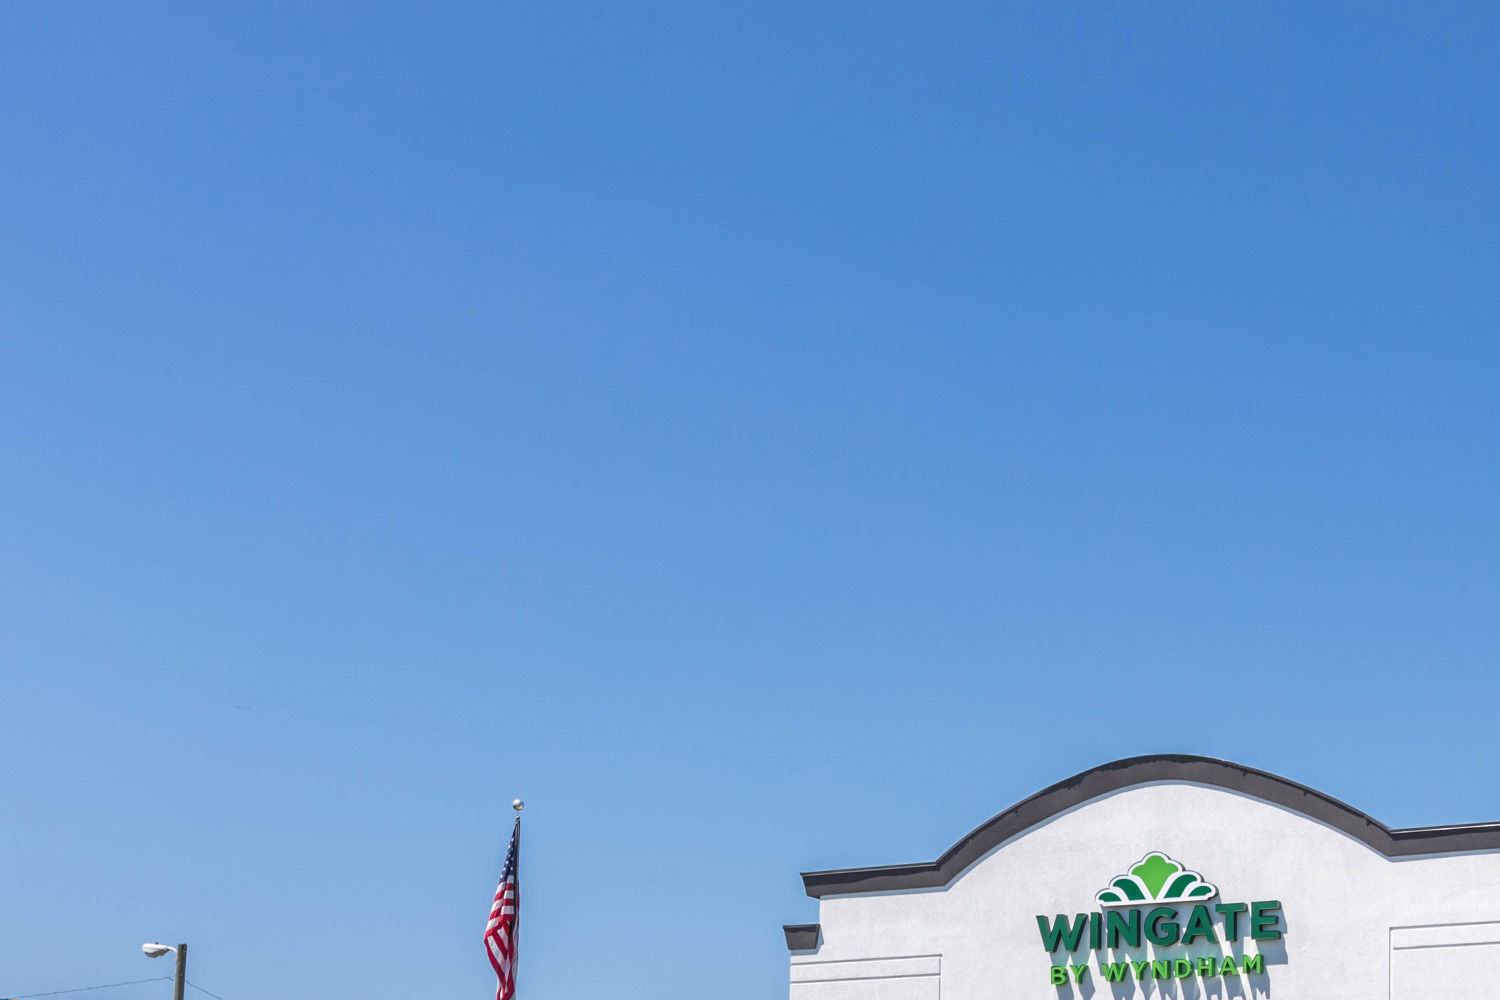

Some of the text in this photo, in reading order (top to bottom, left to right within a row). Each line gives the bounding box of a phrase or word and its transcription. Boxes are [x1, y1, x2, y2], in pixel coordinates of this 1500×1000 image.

[1036, 900, 1281, 953] WINGATE
[1050, 953, 1264, 986] BY WYNDHAM
